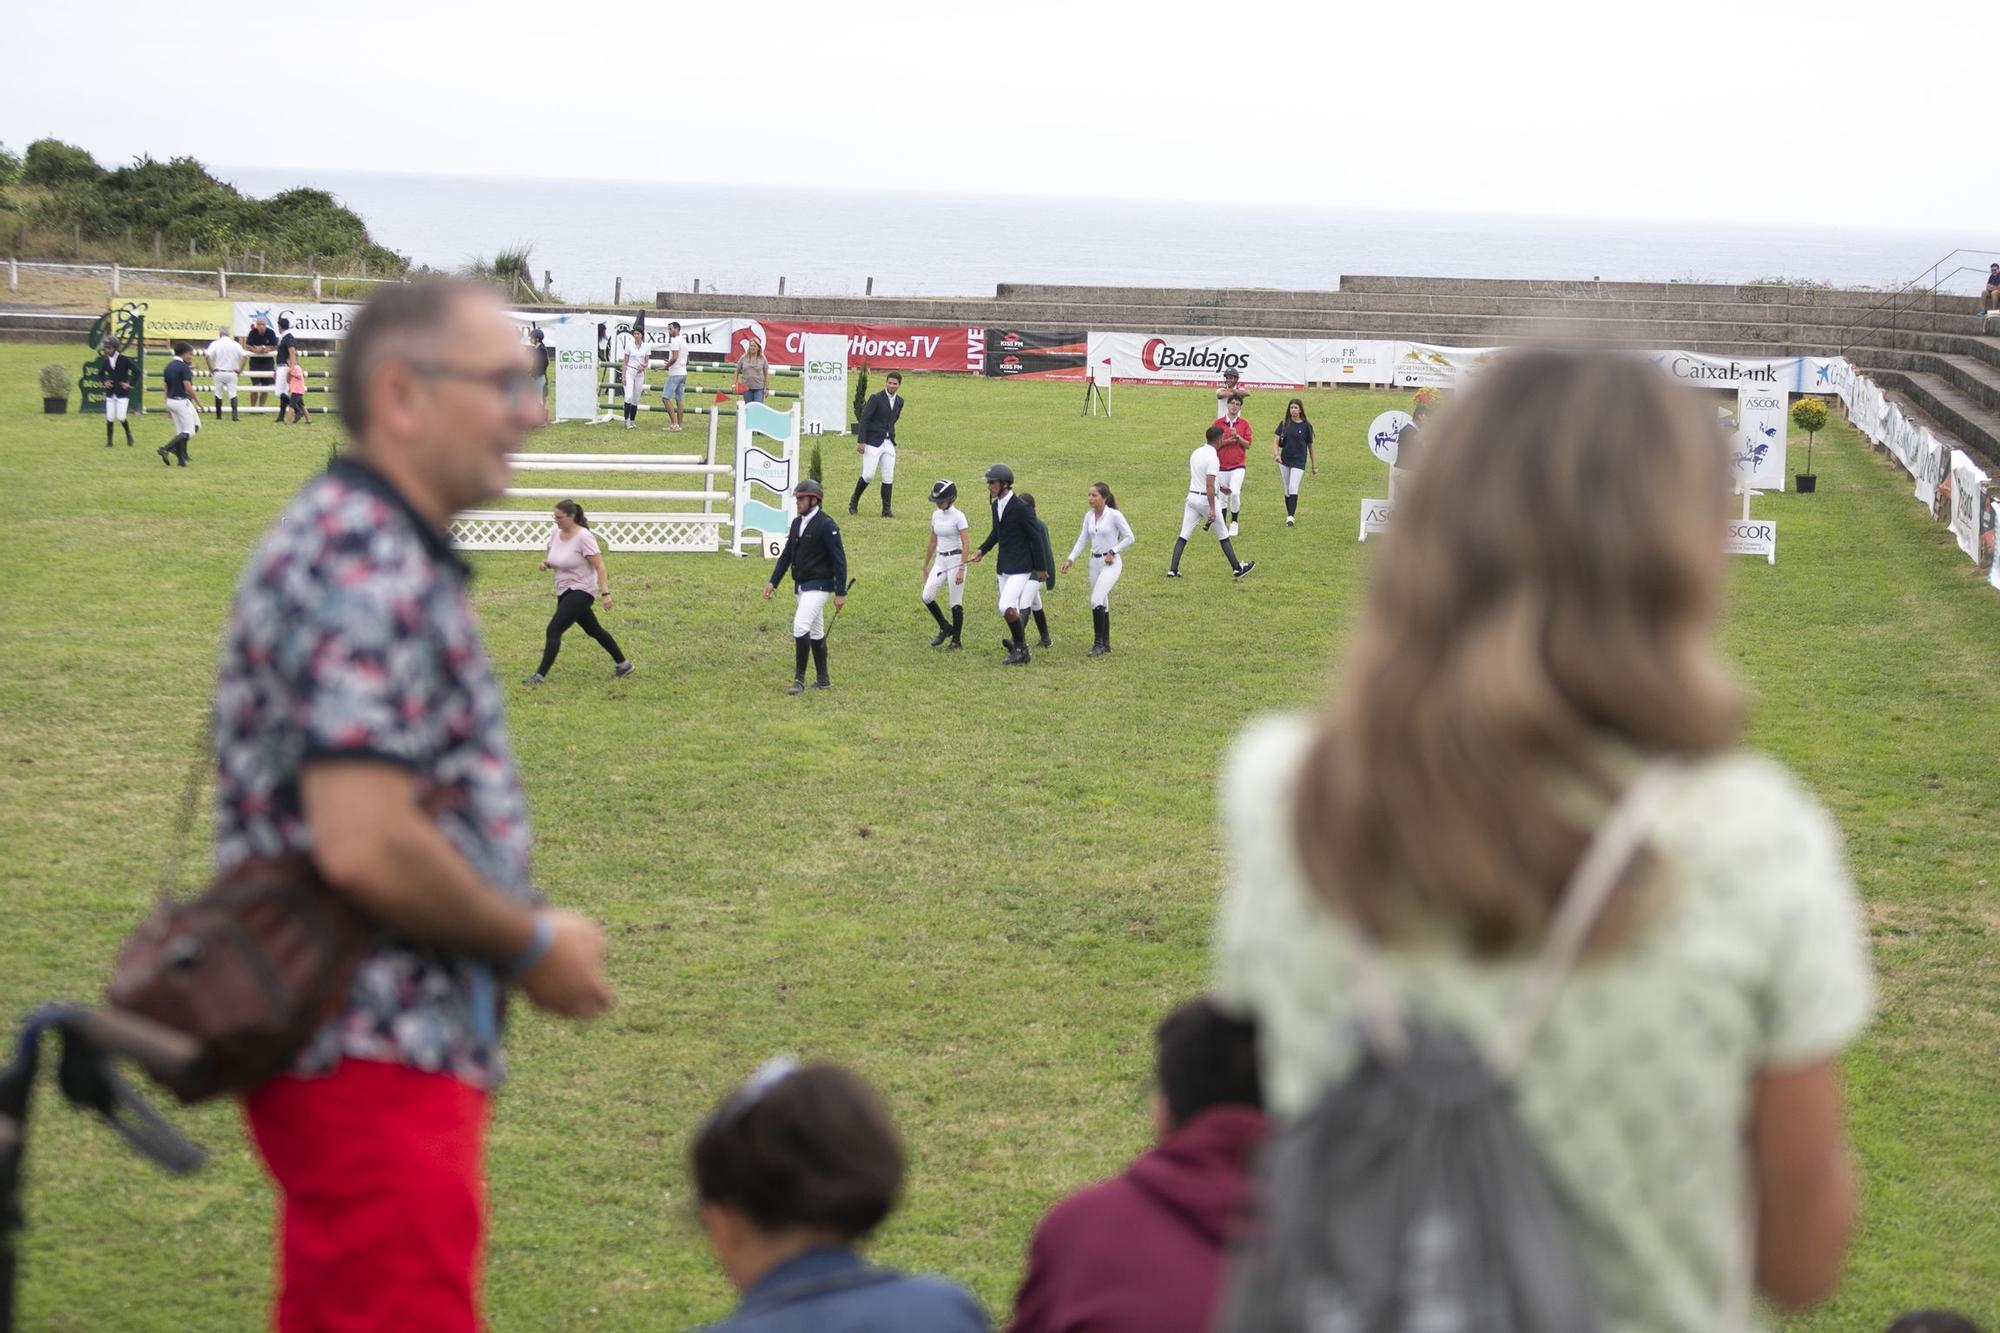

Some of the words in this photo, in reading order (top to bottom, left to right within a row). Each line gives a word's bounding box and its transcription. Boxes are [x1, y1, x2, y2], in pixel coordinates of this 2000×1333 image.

[278, 310, 353, 332] CaixaBa
[785, 332, 939, 358] ClyHorse.TV
[967, 328, 984, 370] LIVE
[560, 363, 592, 371] yeguada
[1160, 346, 1249, 373] Baldajos
[1672, 357, 1777, 382] CaixaBank
[1745, 400, 1780, 409] ASCOR
[809, 422, 821, 435] 11
[1727, 525, 1772, 541] SCOR
[769, 542, 781, 556] 6
